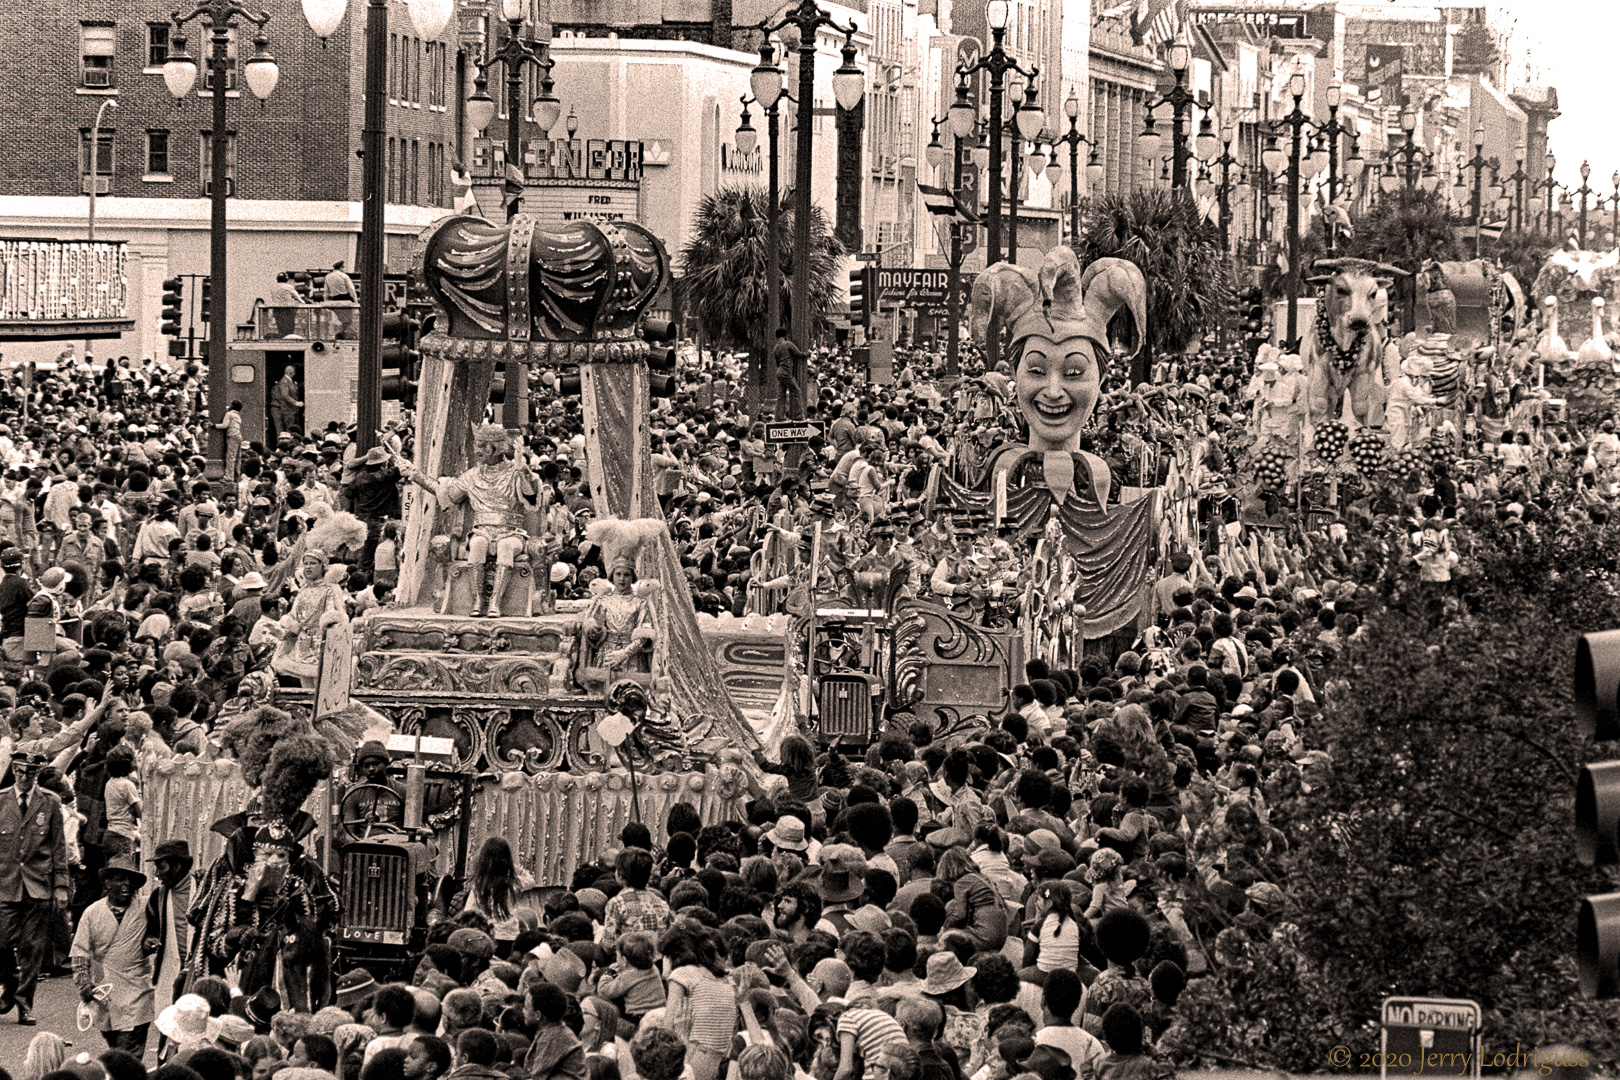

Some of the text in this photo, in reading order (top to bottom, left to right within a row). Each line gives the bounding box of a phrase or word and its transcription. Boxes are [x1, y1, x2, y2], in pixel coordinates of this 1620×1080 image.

[588, 195, 611, 205] FRED
[879, 271, 948, 289] MAYFAIR
[772, 428, 807, 438] ONE WAY
[343, 927, 381, 940] LOVE
[1387, 1005, 1475, 1028] NO PARKING
